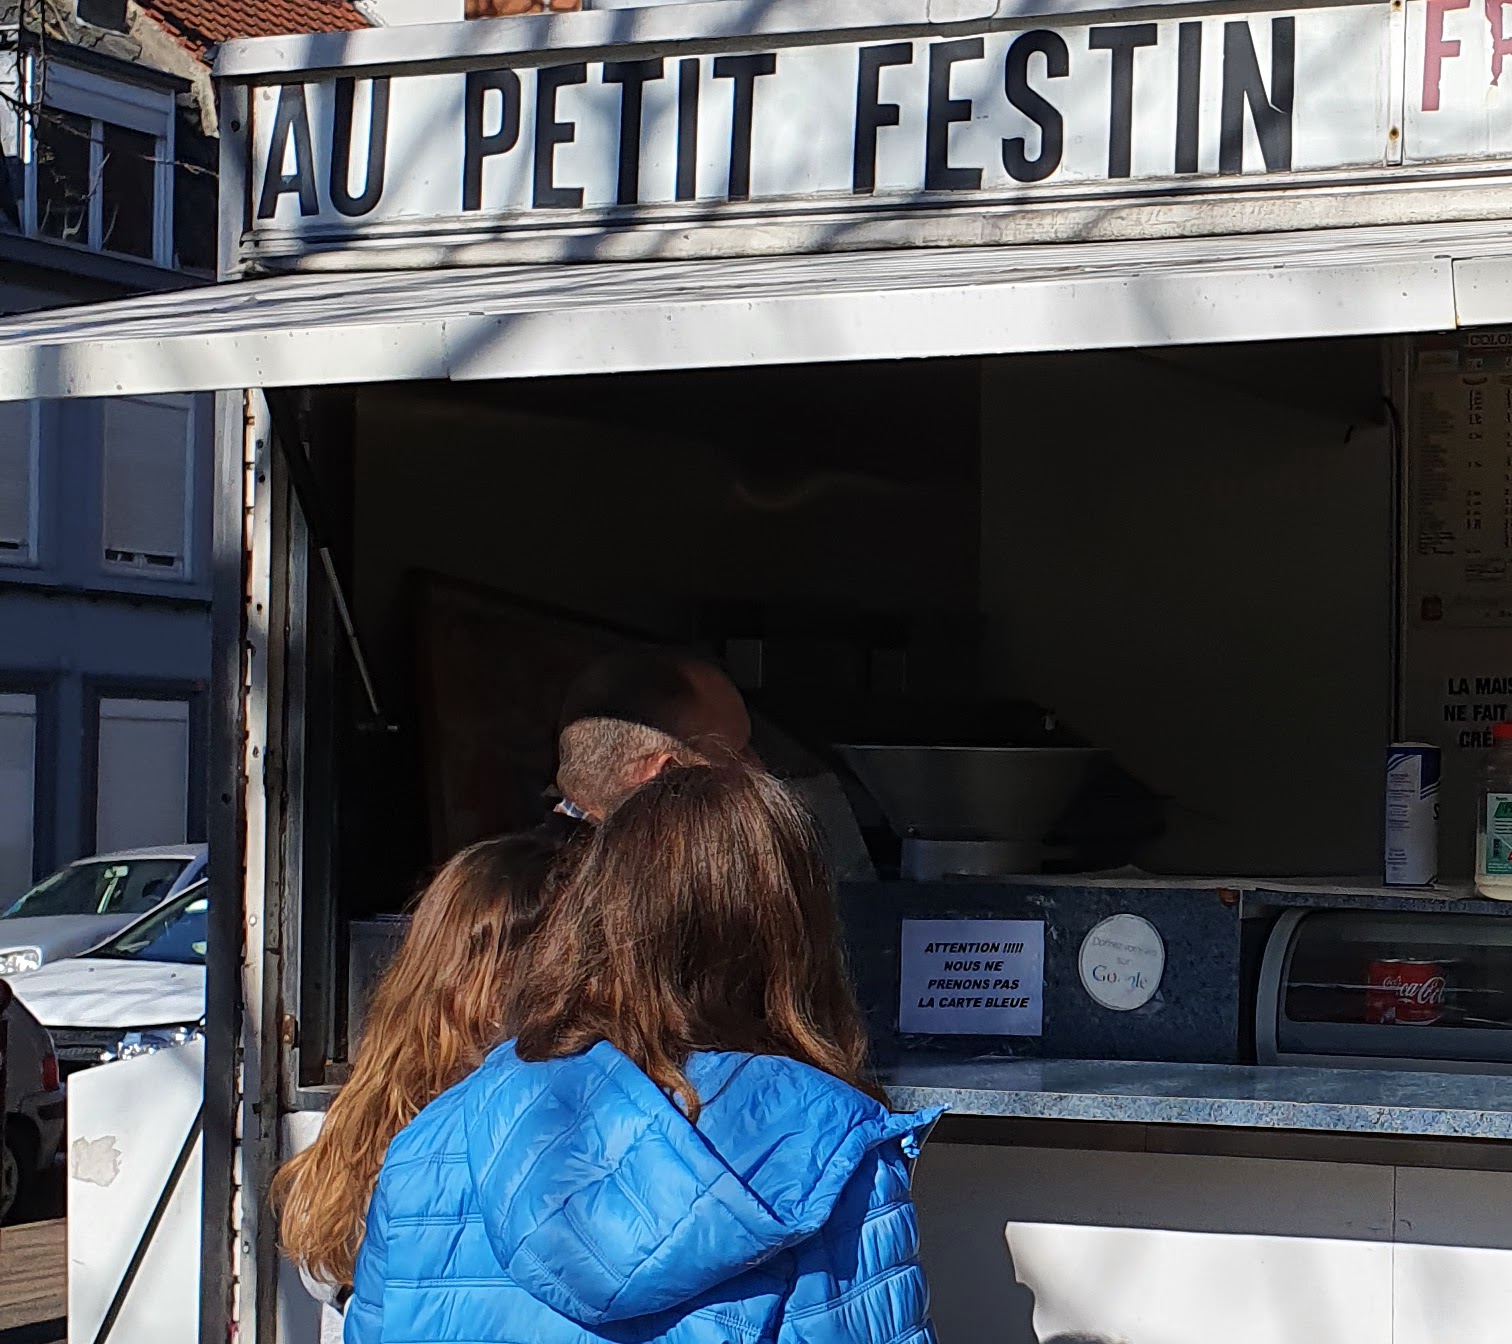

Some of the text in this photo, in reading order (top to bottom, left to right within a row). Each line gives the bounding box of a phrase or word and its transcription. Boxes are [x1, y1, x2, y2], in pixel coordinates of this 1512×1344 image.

[258, 16, 1296, 219] AU PETIT FESTIN
[1448, 678, 1470, 695] LA
[1444, 704, 1467, 722] NE
[1473, 704, 1508, 722] FAIT
[1459, 726, 1496, 748] CRÉ
[924, 942, 1000, 954] ATTENTION
[944, 960, 1004, 972] NOUS NE
[927, 978, 1020, 990] PRENONS PAS
[1092, 964, 1148, 990] Gogle
[917, 996, 1030, 1008] LA CARTE BLEUE
